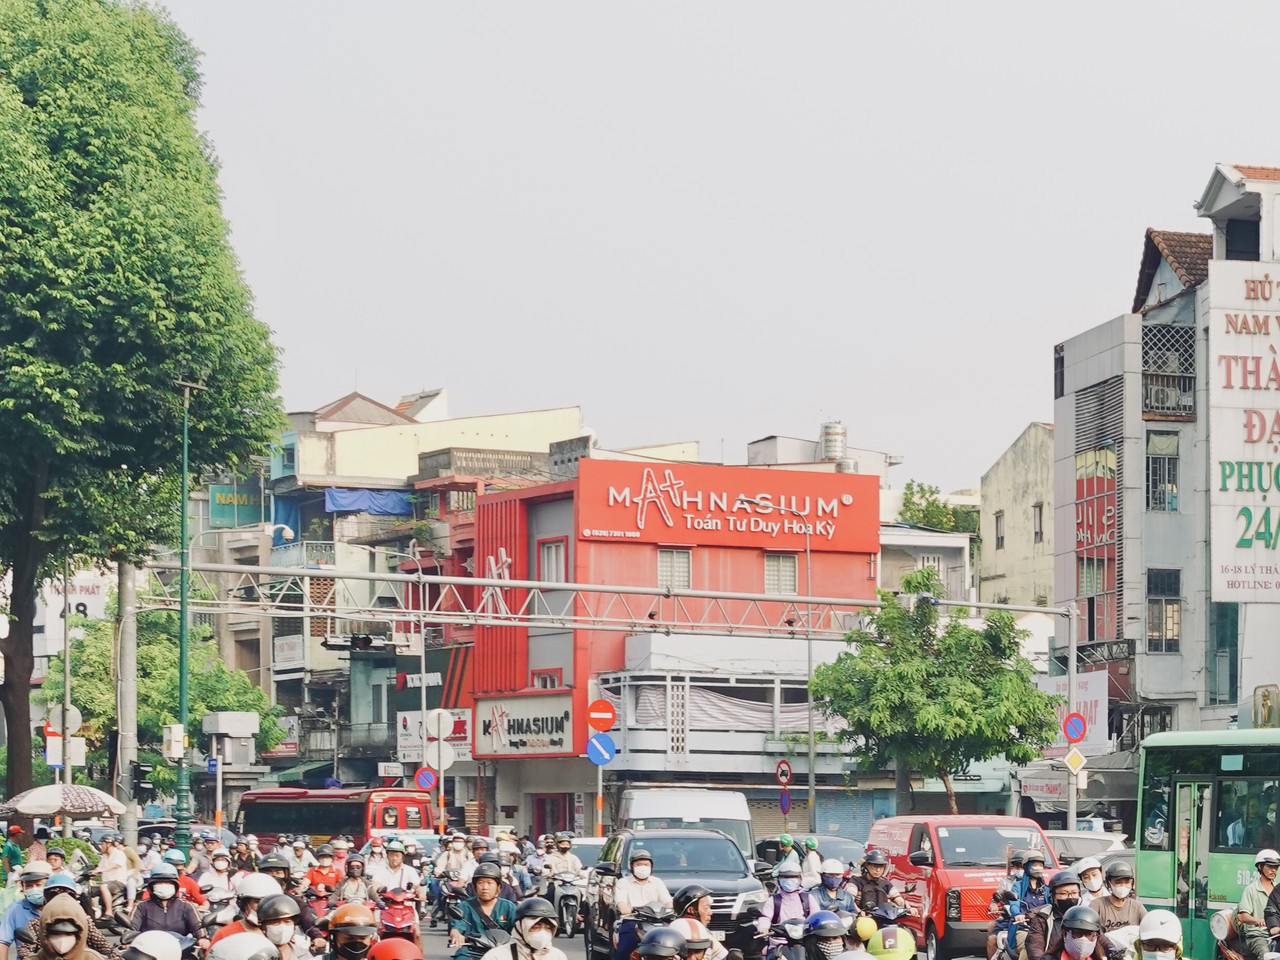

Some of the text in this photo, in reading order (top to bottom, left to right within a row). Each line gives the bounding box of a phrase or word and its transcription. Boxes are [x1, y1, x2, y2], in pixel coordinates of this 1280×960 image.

[1244, 273, 1273, 301] HỦ
[1225, 314, 1269, 337] NAM
[684, 514, 836, 540] Toán Tư Duy Hoa Kỳ
[1220, 565, 1242, 575] 16-18
[1227, 580, 1272, 590] HOTLINE:
